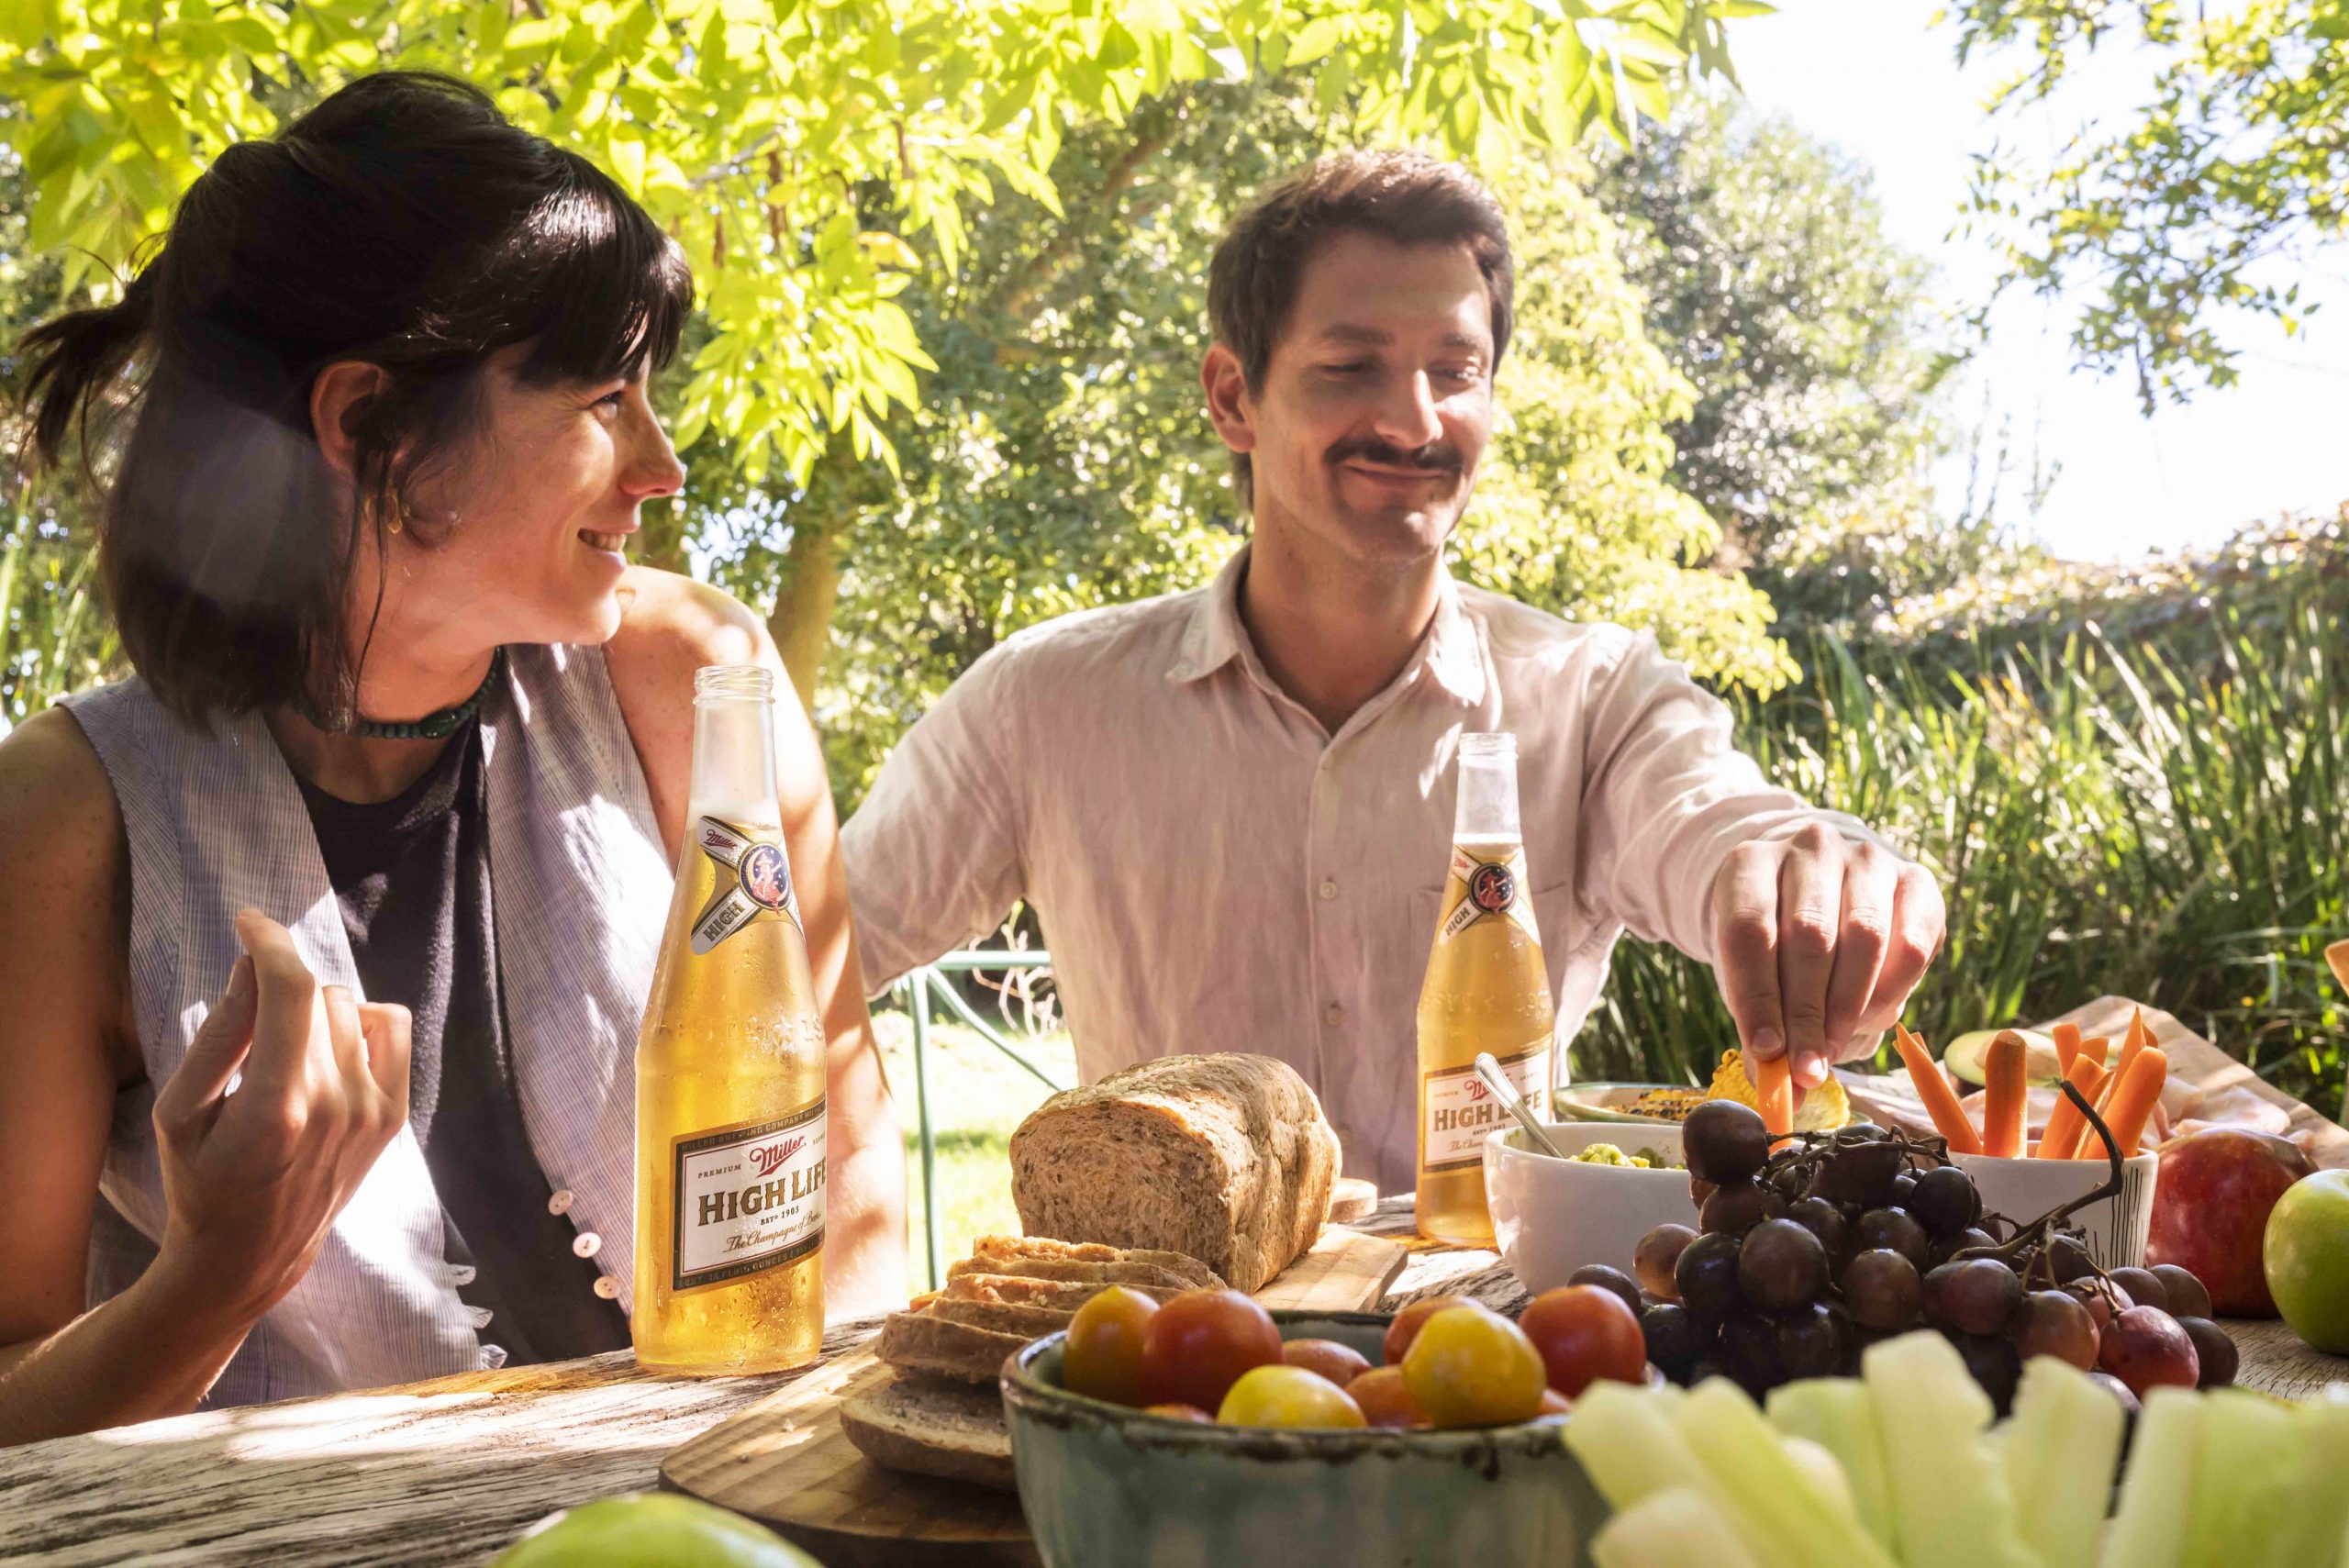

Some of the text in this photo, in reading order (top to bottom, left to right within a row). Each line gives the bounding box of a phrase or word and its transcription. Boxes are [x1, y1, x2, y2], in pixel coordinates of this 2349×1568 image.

[706, 828, 738, 850] Miller
[703, 902, 745, 942] HIGH
[1444, 907, 1471, 937] HIGH
[1433, 1089, 1542, 1132] HIGH LFE
[682, 1113, 803, 1152] MILLER BREWING COMPANY
[750, 1134, 806, 1177] Miller
[697, 1163, 742, 1179] PREMIUM
[697, 1177, 786, 1227] HIGH
[782, 1206, 799, 1219] 1903
[722, 1237, 746, 1252] The
[746, 1224, 797, 1248] Champagne
[752, 1251, 787, 1271] OUNCES
